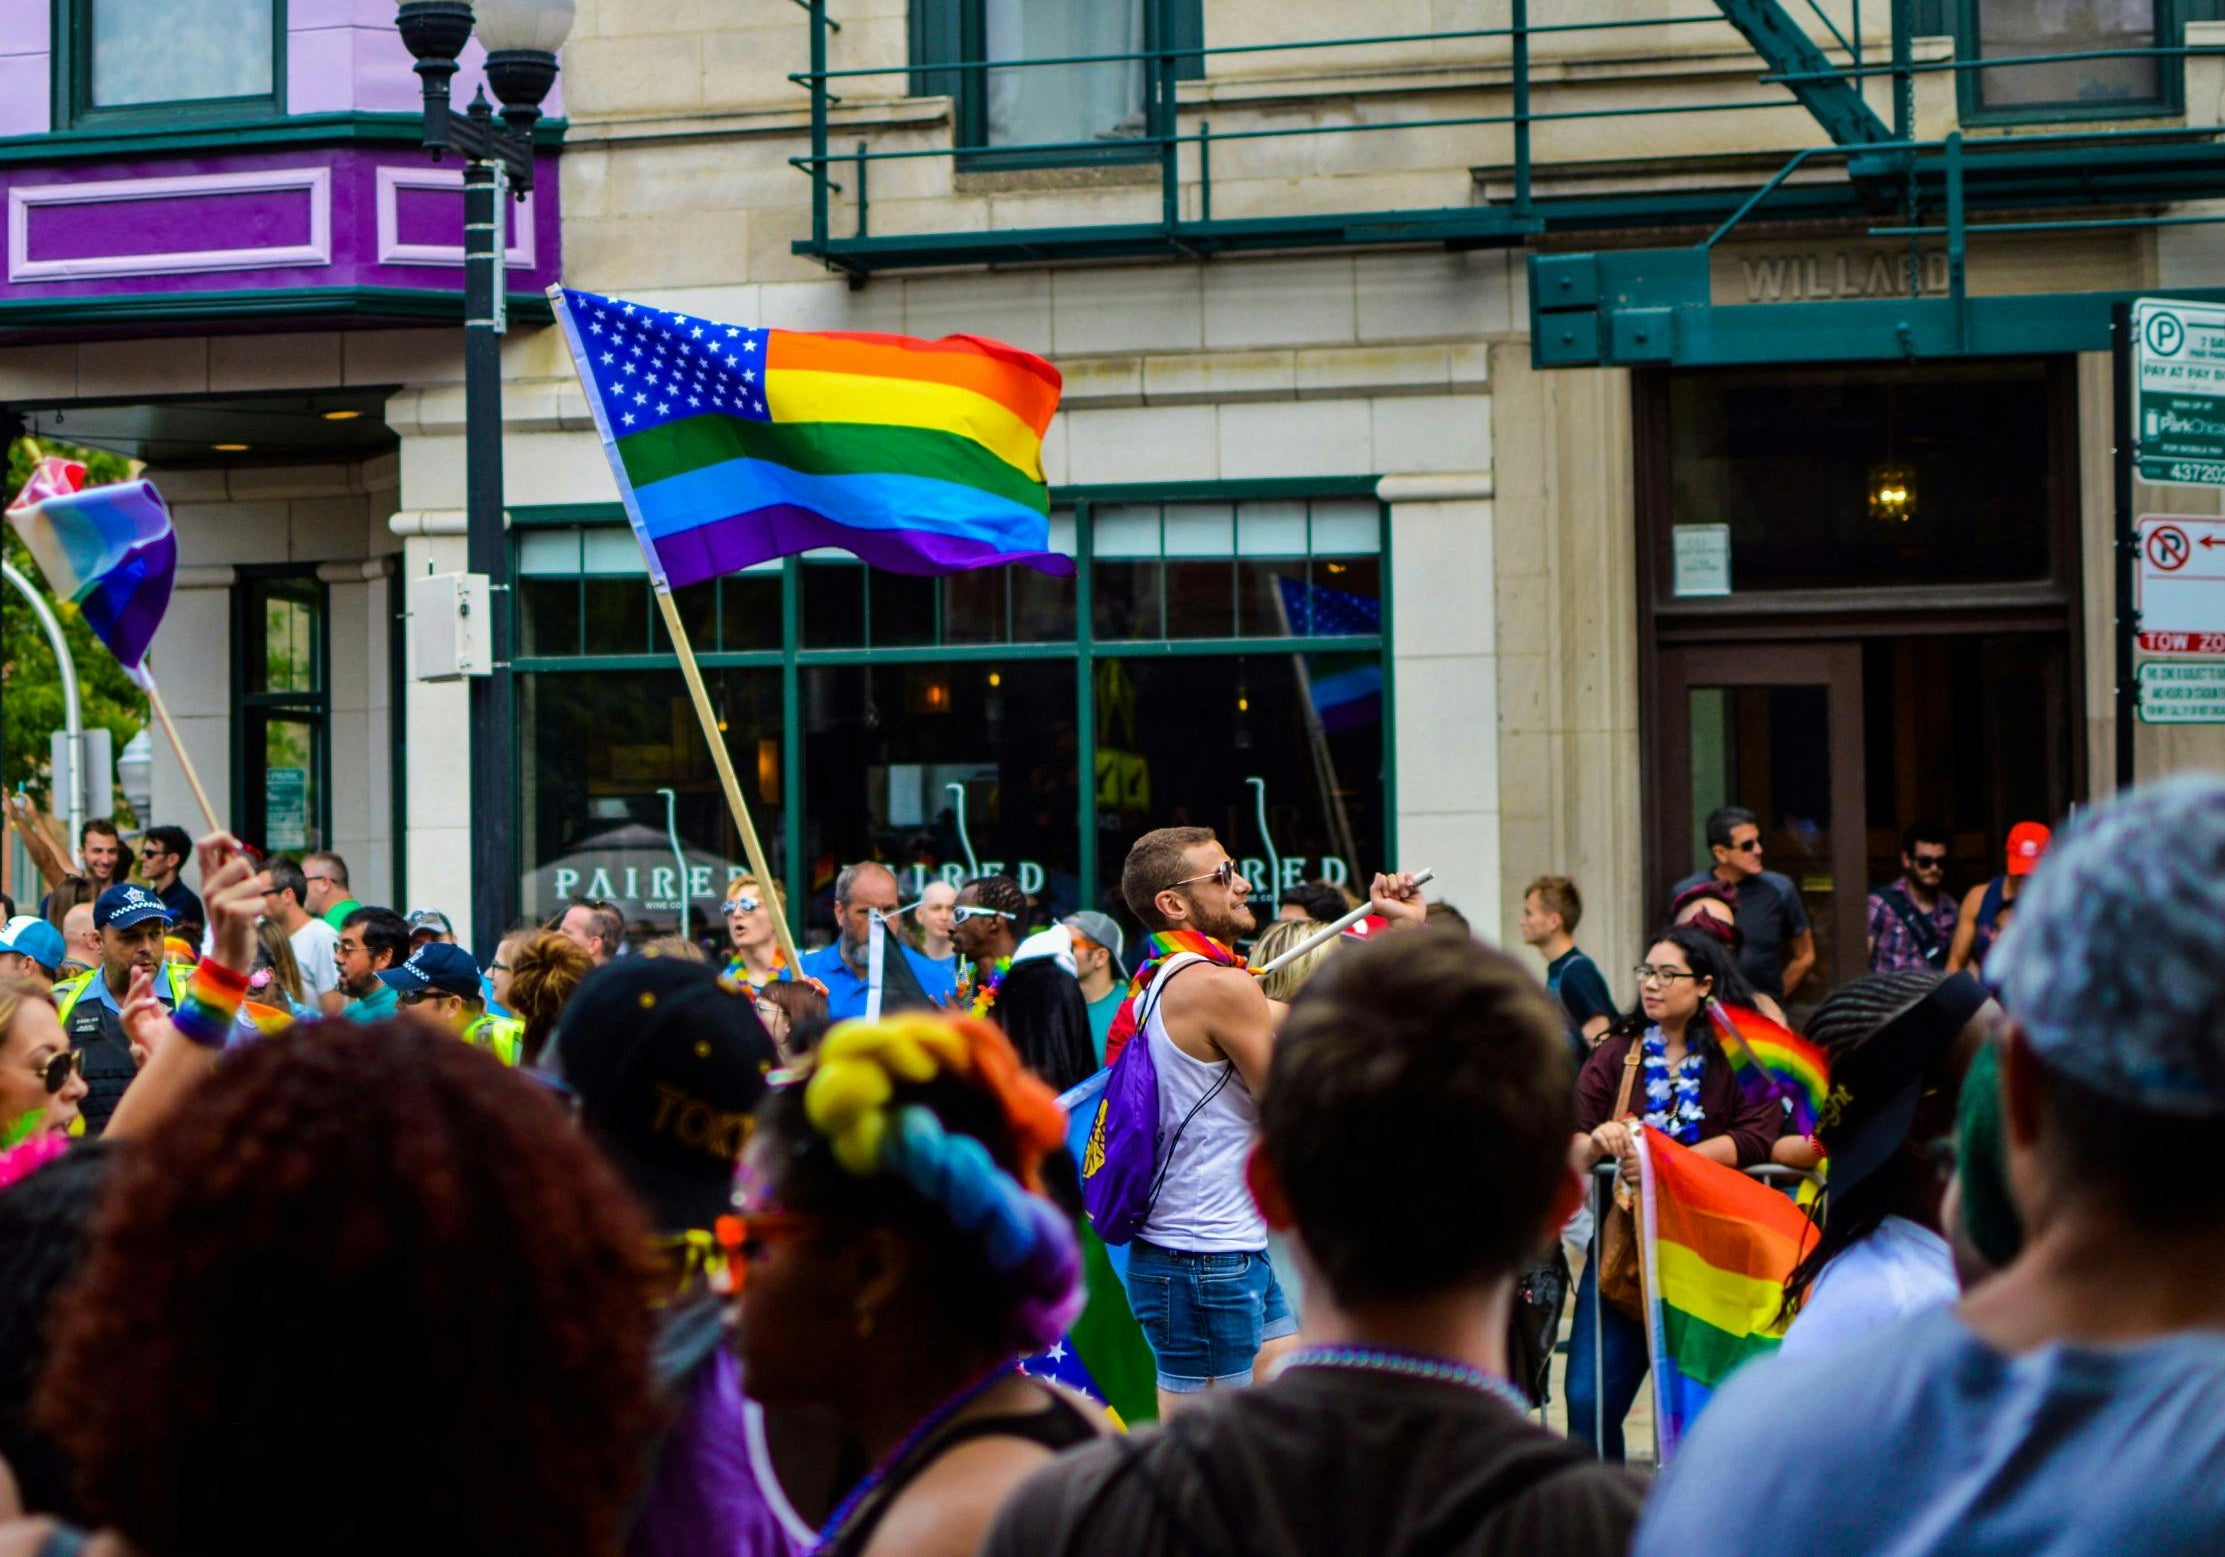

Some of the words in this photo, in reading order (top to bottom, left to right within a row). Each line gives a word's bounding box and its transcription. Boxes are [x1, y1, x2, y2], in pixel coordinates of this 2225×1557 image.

[1743, 252, 1949, 301] WILLARD
[2144, 365, 2167, 376] PAY
[2170, 367, 2183, 377] AT
[2187, 368, 2210, 379] PAY
[2147, 632, 2189, 650] TOW
[645, 901, 667, 911] WINE
